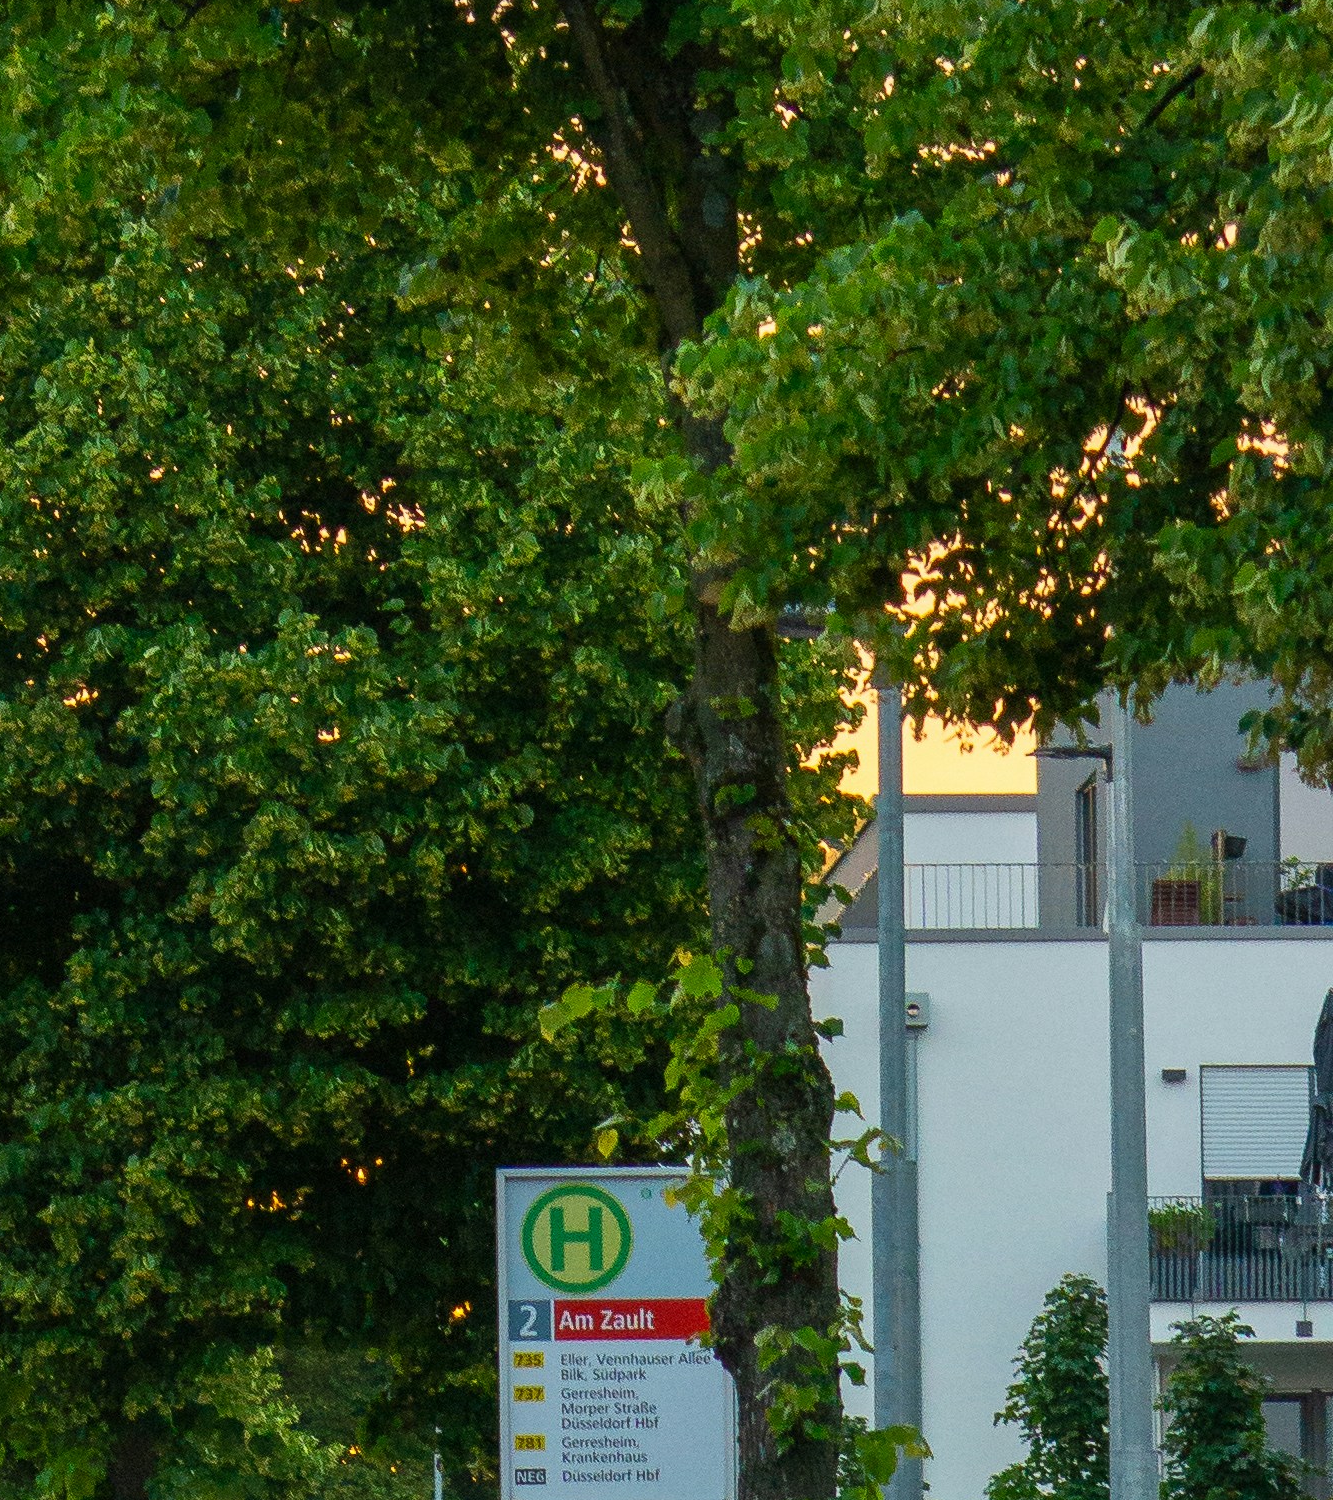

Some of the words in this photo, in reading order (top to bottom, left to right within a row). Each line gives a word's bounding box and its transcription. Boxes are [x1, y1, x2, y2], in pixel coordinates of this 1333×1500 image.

[549, 1206, 604, 1272] H
[519, 1305, 538, 1337] 2
[559, 1310, 594, 1331] Am
[600, 1308, 655, 1331] Zault
[560, 1353, 592, 1368] Eller,
[596, 1353, 674, 1366] Vennhauser
[678, 1352, 711, 1365] Allee
[592, 1368, 647, 1384] Südpark
[561, 1387, 639, 1401] Gerresheim,
[561, 1403, 610, 1417] Morper
[614, 1402, 658, 1415] Straße
[561, 1417, 631, 1431] Düsseldorf
[635, 1416, 660, 1429] Hbf
[561, 1436, 640, 1450] Gerresheim,
[562, 1451, 649, 1464] Krankenhaus
[562, 1469, 632, 1483] Düsseldorf
[636, 1468, 661, 1482] Hbf
